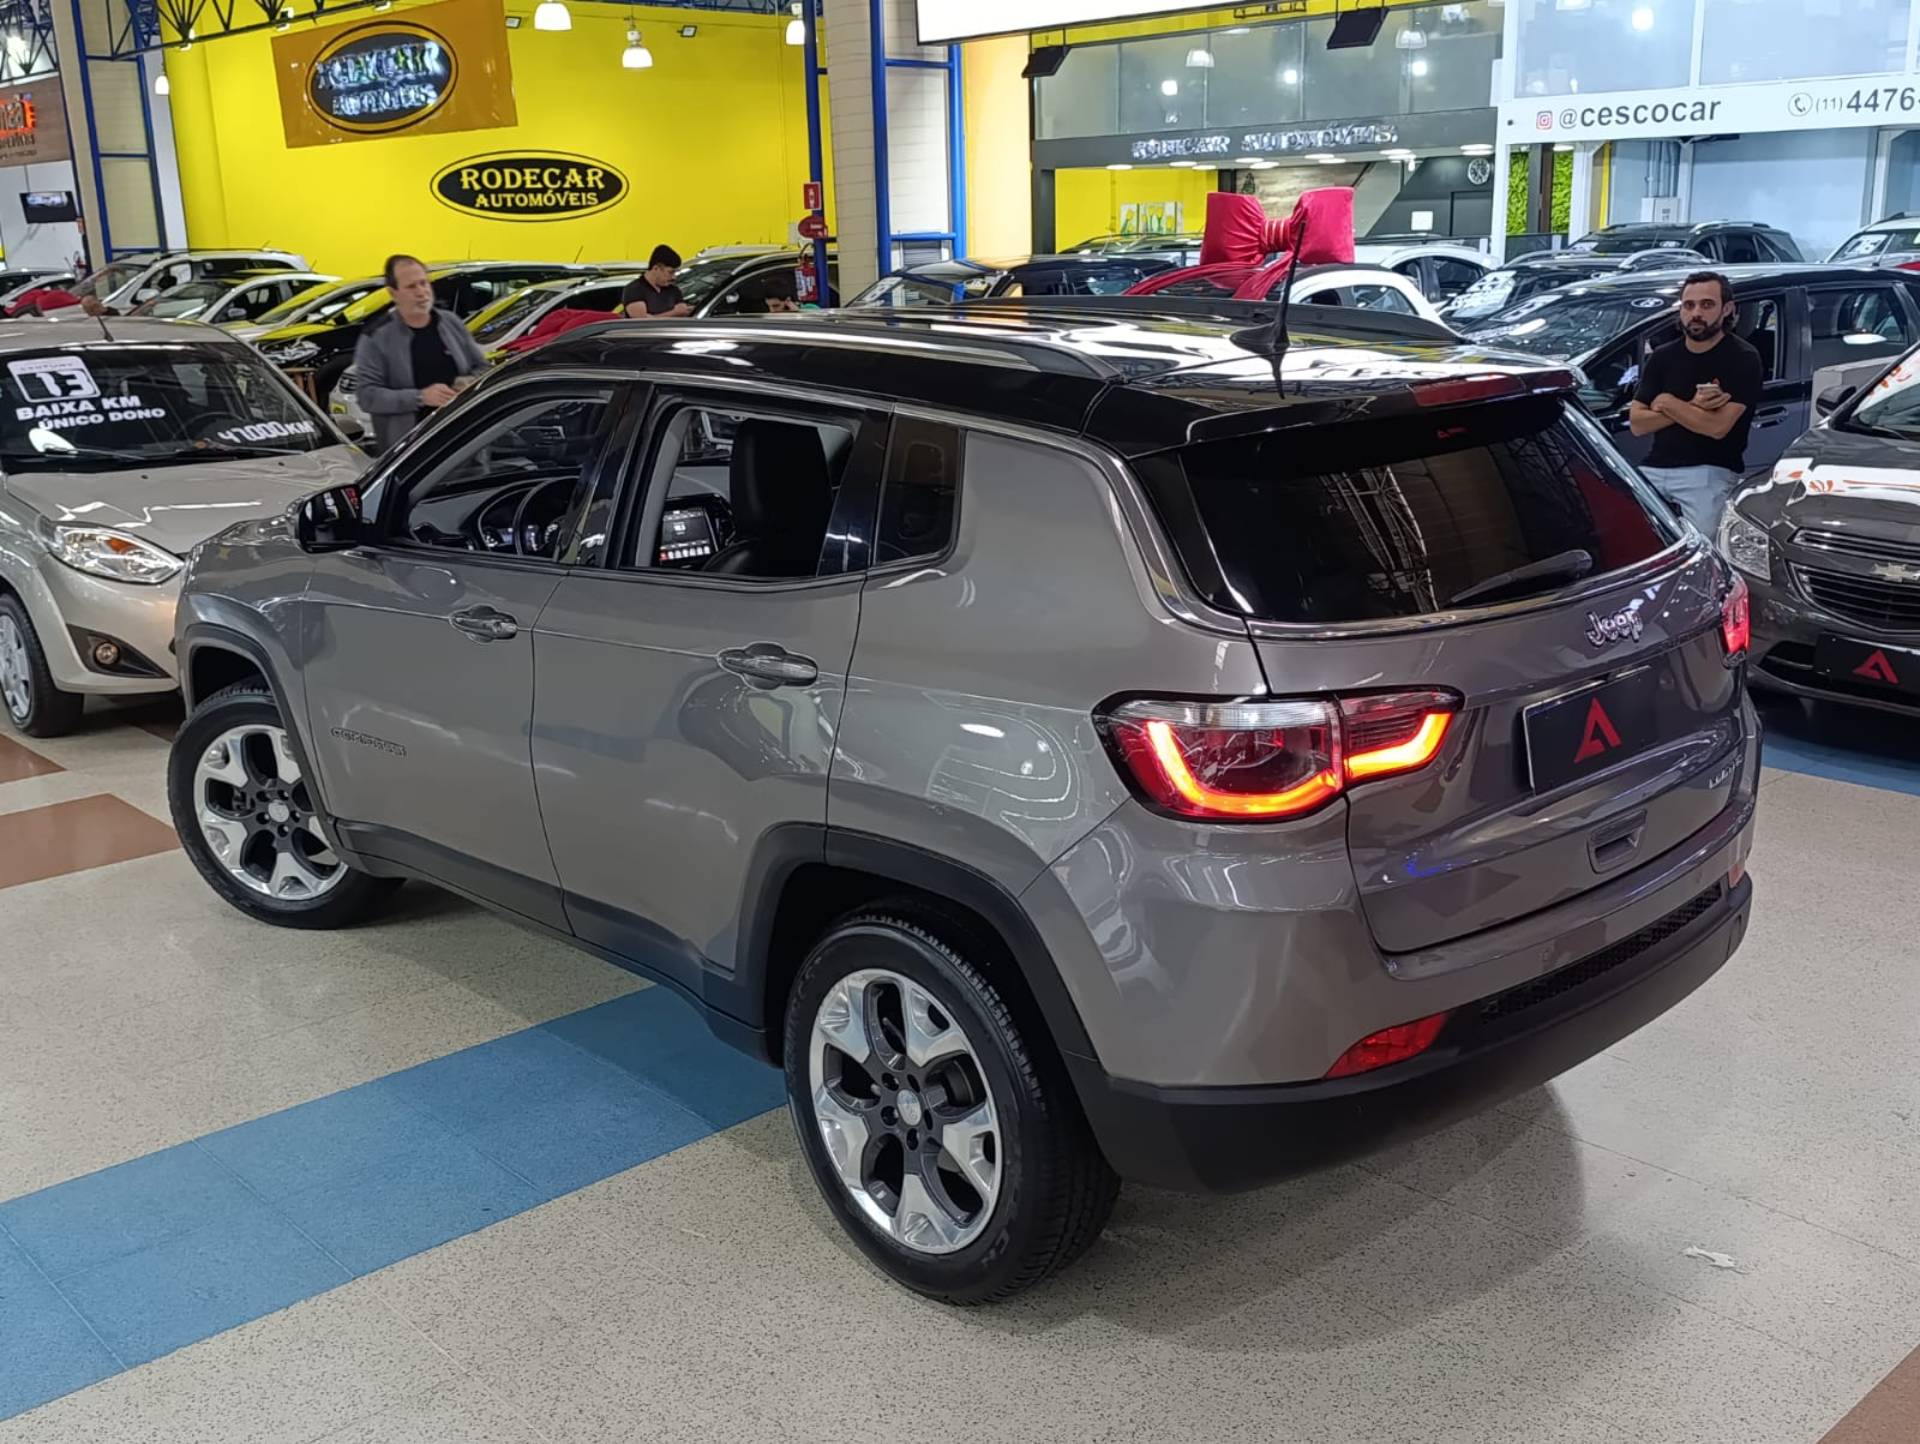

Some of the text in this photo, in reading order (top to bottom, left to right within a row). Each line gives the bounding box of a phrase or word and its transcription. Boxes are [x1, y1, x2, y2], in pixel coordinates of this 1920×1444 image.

[1846, 87, 1920, 113] 4476
[1559, 100, 1721, 130] @cescocar
[460, 168, 605, 191] RODECAR
[475, 190, 599, 208] AUTOMÓVEIS
[35, 371, 94, 397] 13
[16, 395, 141, 421] BAIXA KM
[38, 408, 165, 430] ÚNICO DONO
[1586, 608, 1643, 646] Jeep
